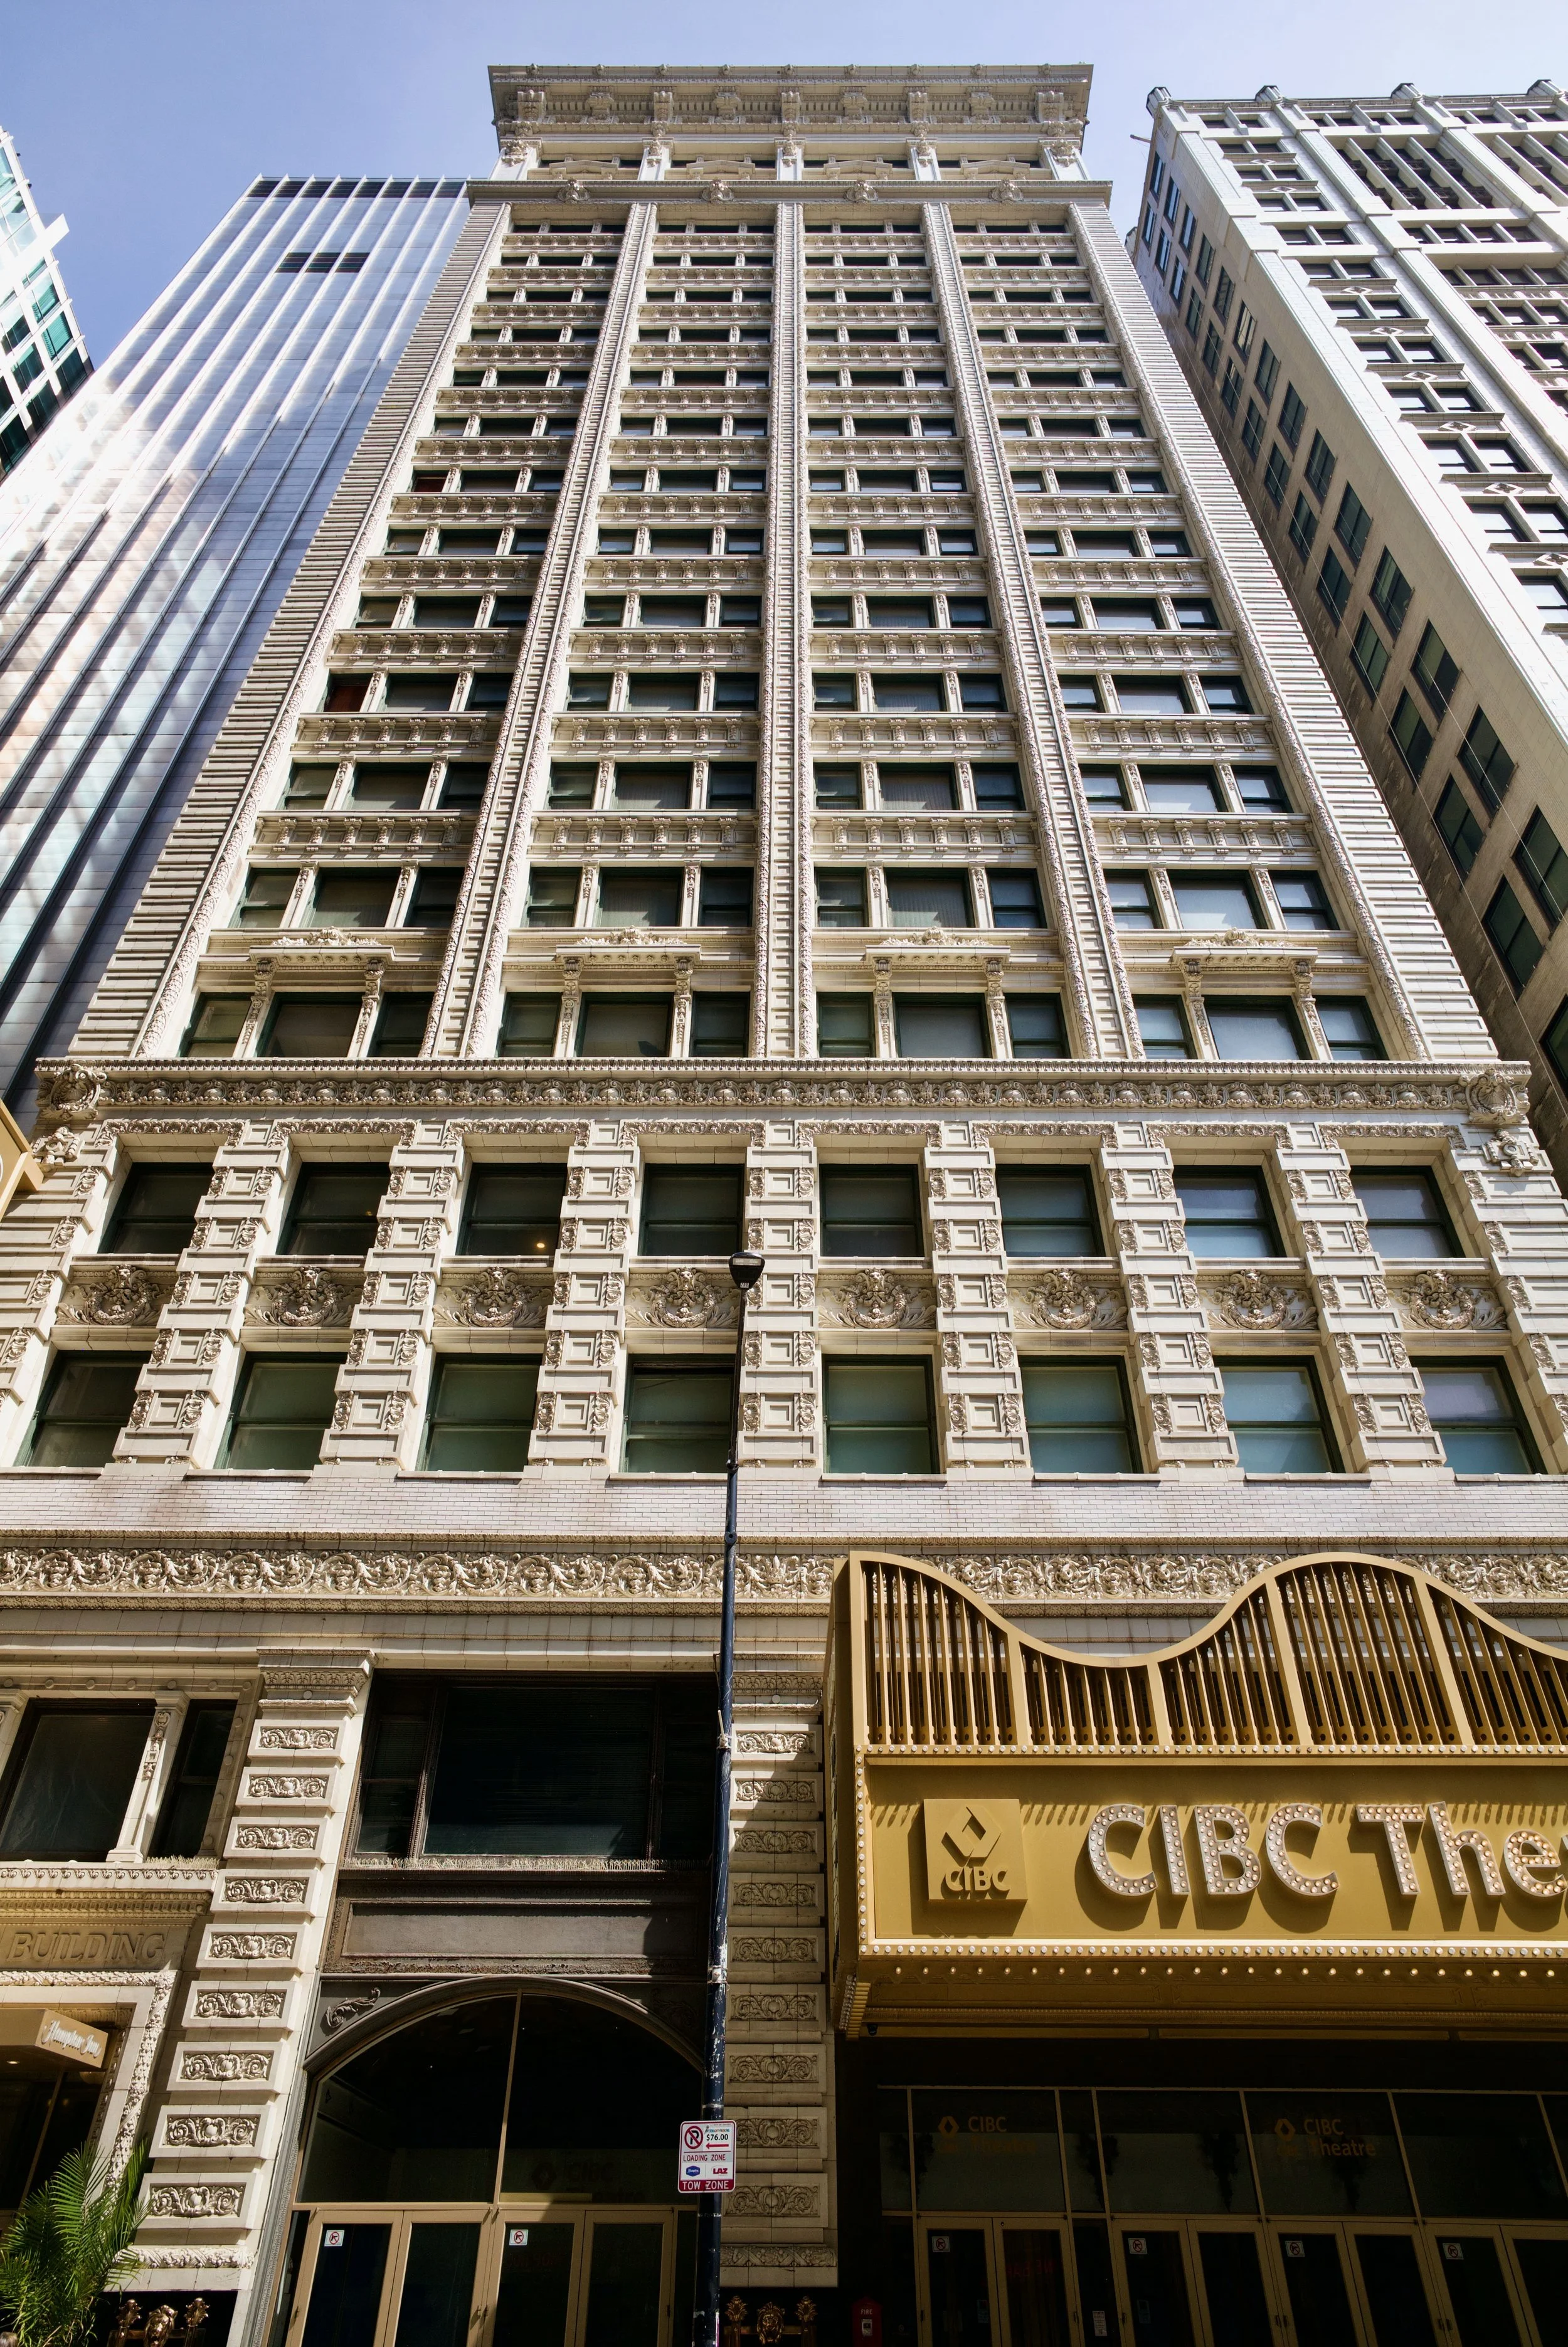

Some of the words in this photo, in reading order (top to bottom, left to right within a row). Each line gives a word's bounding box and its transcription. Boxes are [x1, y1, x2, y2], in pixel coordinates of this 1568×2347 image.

[1088, 1803, 1340, 1895] CIBC
[1355, 1801, 1568, 1897] The
[945, 1865, 1012, 1891] CIBC
[5, 1932, 166, 1964] BUILDING
[41, 2019, 83, 2050] Hampton
[80, 2034, 102, 2058] Inn
[968, 2116, 1008, 2132] CIBC
[1304, 2119, 1345, 2136] CIBC
[682, 2181, 701, 2190] TOW
[706, 2181, 729, 2190] ZONE
